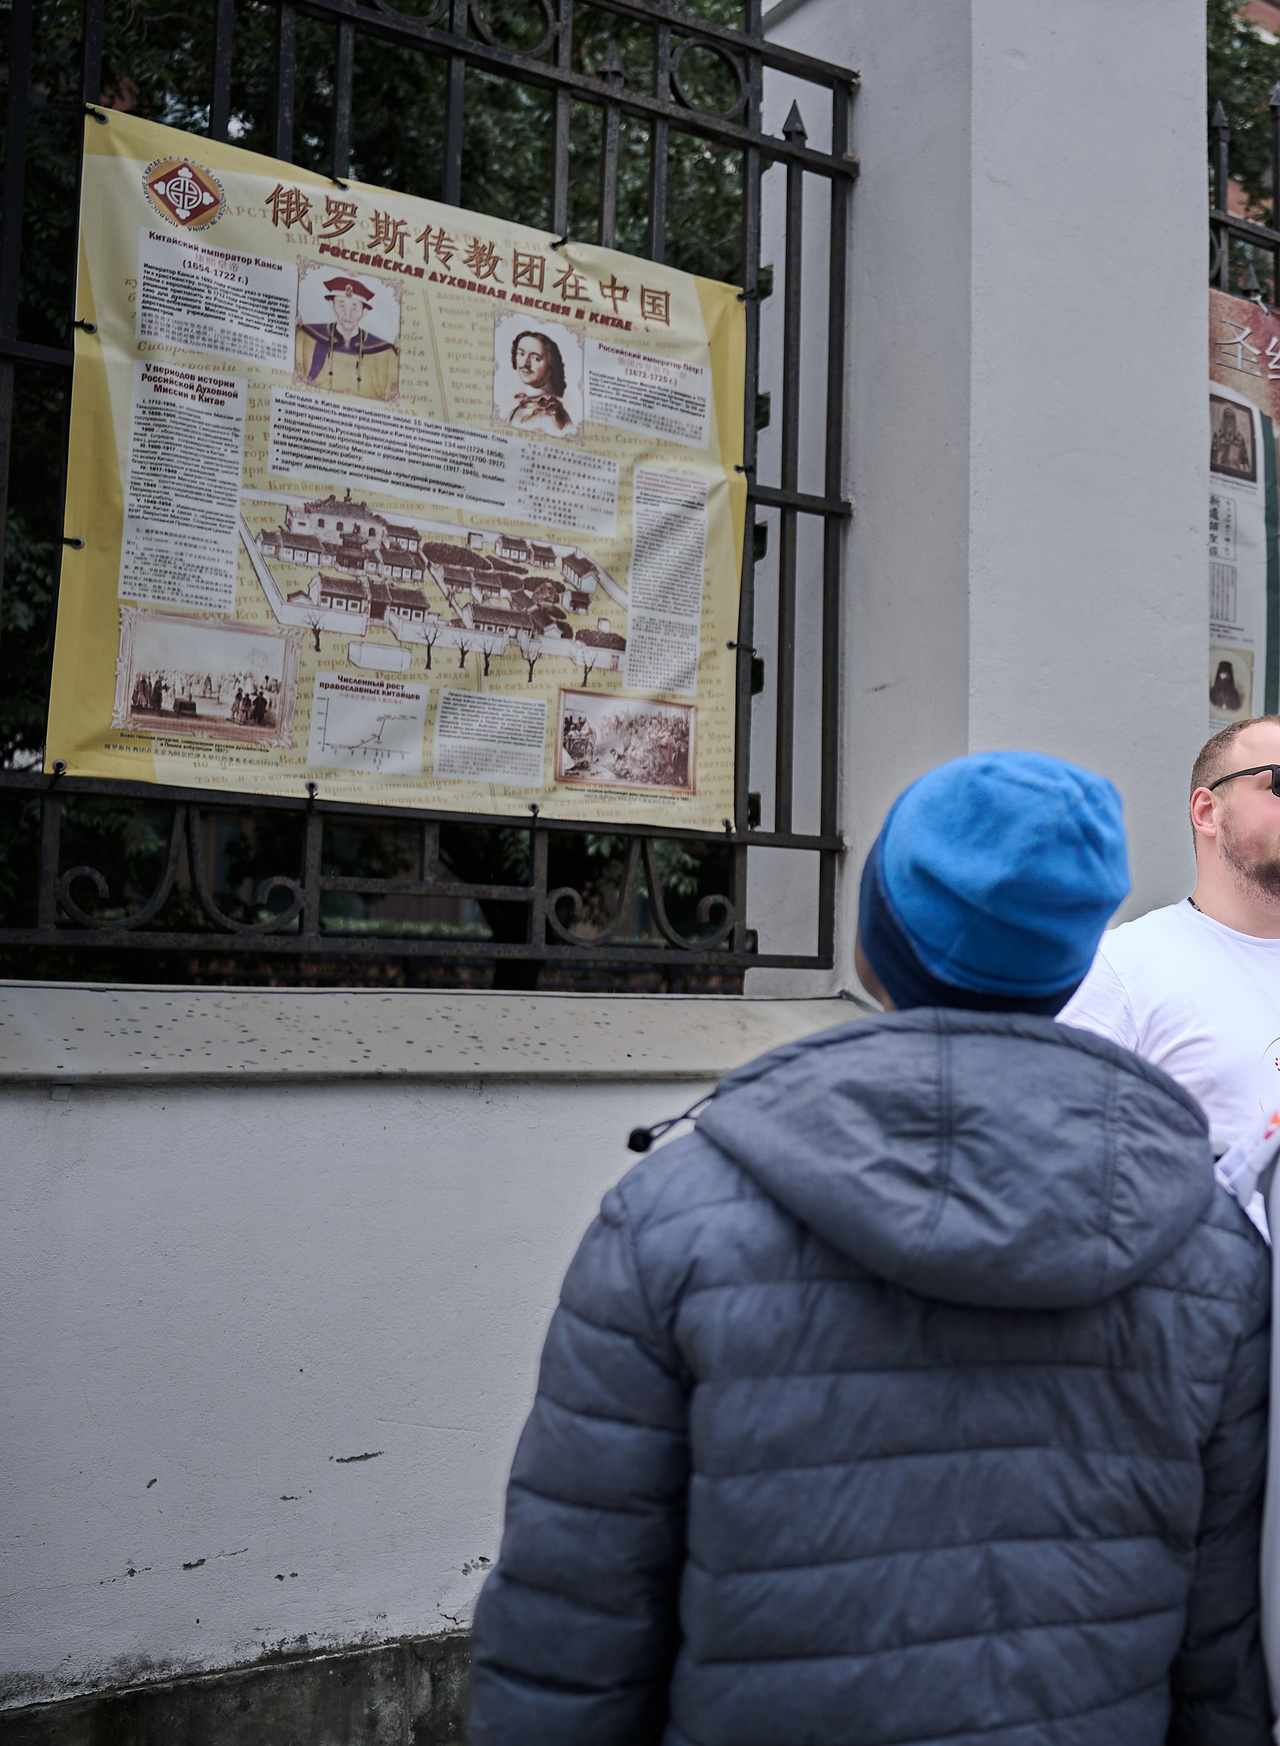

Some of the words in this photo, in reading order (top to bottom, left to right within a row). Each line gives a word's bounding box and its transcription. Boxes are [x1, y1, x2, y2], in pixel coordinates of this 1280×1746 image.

[144, 158, 163, 175] КИТАЕ
[187, 223, 211, 232] CHINA
[149, 230, 198, 251] Китайский
[201, 245, 252, 266] император
[254, 257, 282, 271] Канси
[265, 183, 671, 326] 俄罗斯传教团在中国
[143, 262, 176, 275] Император
[177, 270, 194, 279] Канси
[182, 258, 235, 281] (1654-1722
[238, 274, 248, 285] г.)
[318, 243, 426, 280] РОССИЙСКАЯ
[428, 271, 507, 300] ДУХОВНАЯ
[510, 292, 572, 315] МИССИЯ
[575, 308, 586, 320] В
[589, 312, 633, 332] КИТАЕ
[598, 342, 640, 359] Российский
[643, 354, 680, 370] император
[683, 363, 699, 374] Пётр
[145, 362, 151, 372] V
[153, 364, 195, 381] периодов
[198, 374, 234, 389] истории
[141, 372, 194, 391] Российской
[196, 382, 238, 400] Духовной
[153, 383, 188, 399] Миссии
[198, 394, 225, 406] Китае
[275, 397, 295, 406] малая
[297, 402, 337, 415] численность
[285, 391, 312, 403] Сегодня
[321, 399, 340, 409] Китае
[343, 404, 390, 419] насчитывается
[393, 415, 411, 423] около
[424, 421, 442, 430] тысяч
[492, 434, 508, 443] Столь
[285, 408, 307, 418] запрет
[307, 413, 352, 428] христианской
[394, 430, 411, 439] Китае
[335, 427, 361, 440] Русской
[328, 441, 349, 451] забота
[351, 445, 375, 456] Миссии
[272, 463, 289, 473] этапе
[281, 457, 302, 468] запрет
[337, 460, 365, 470] политика
[319, 681, 379, 696] православных
[381, 688, 420, 700] китайцев
[337, 674, 385, 688] Численный
[387, 681, 404, 691] рост
